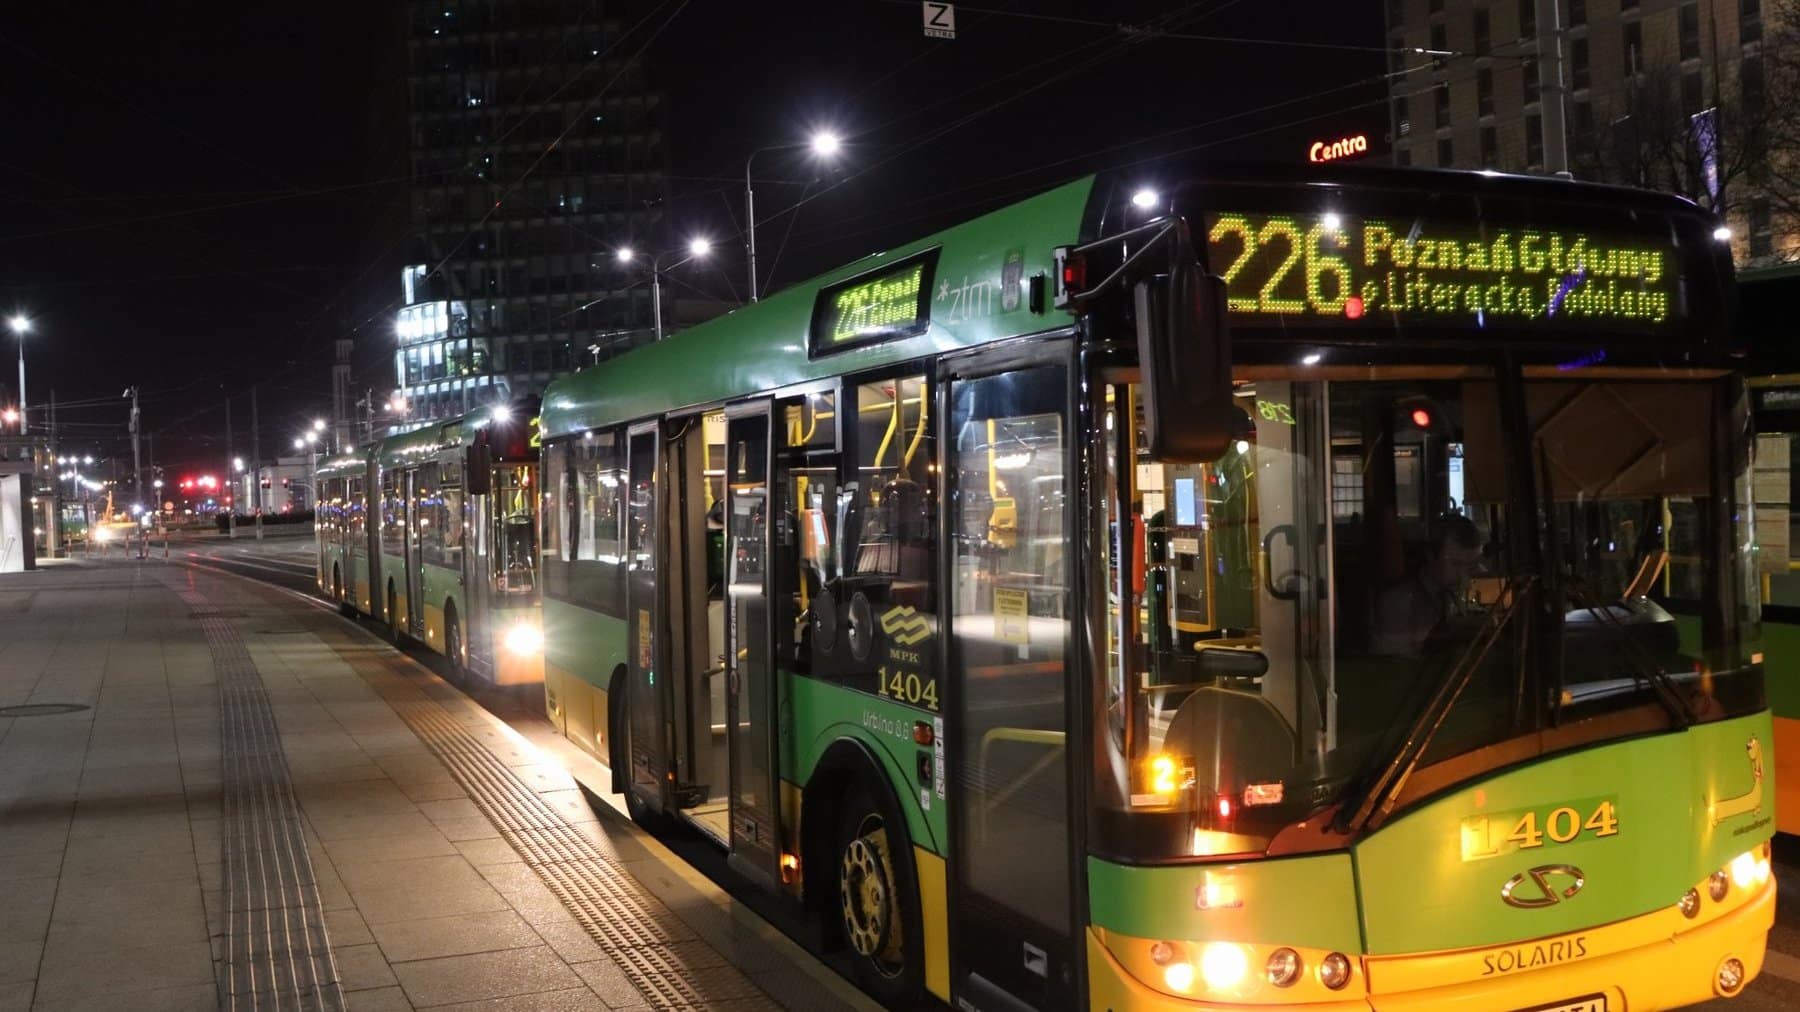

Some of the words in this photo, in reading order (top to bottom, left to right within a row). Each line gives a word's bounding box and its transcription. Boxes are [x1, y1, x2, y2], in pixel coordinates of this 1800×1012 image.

[927, 3, 949, 27] Z
[1309, 135, 1367, 162] Centra
[1208, 215, 1351, 316] 226
[1363, 223, 1513, 273] Poznań
[1519, 231, 1664, 283] Główny
[889, 648, 919, 663] MPK
[878, 666, 939, 710] 1404
[1470, 800, 1618, 858] 1404
[1482, 937, 1587, 976] SOLARIS
